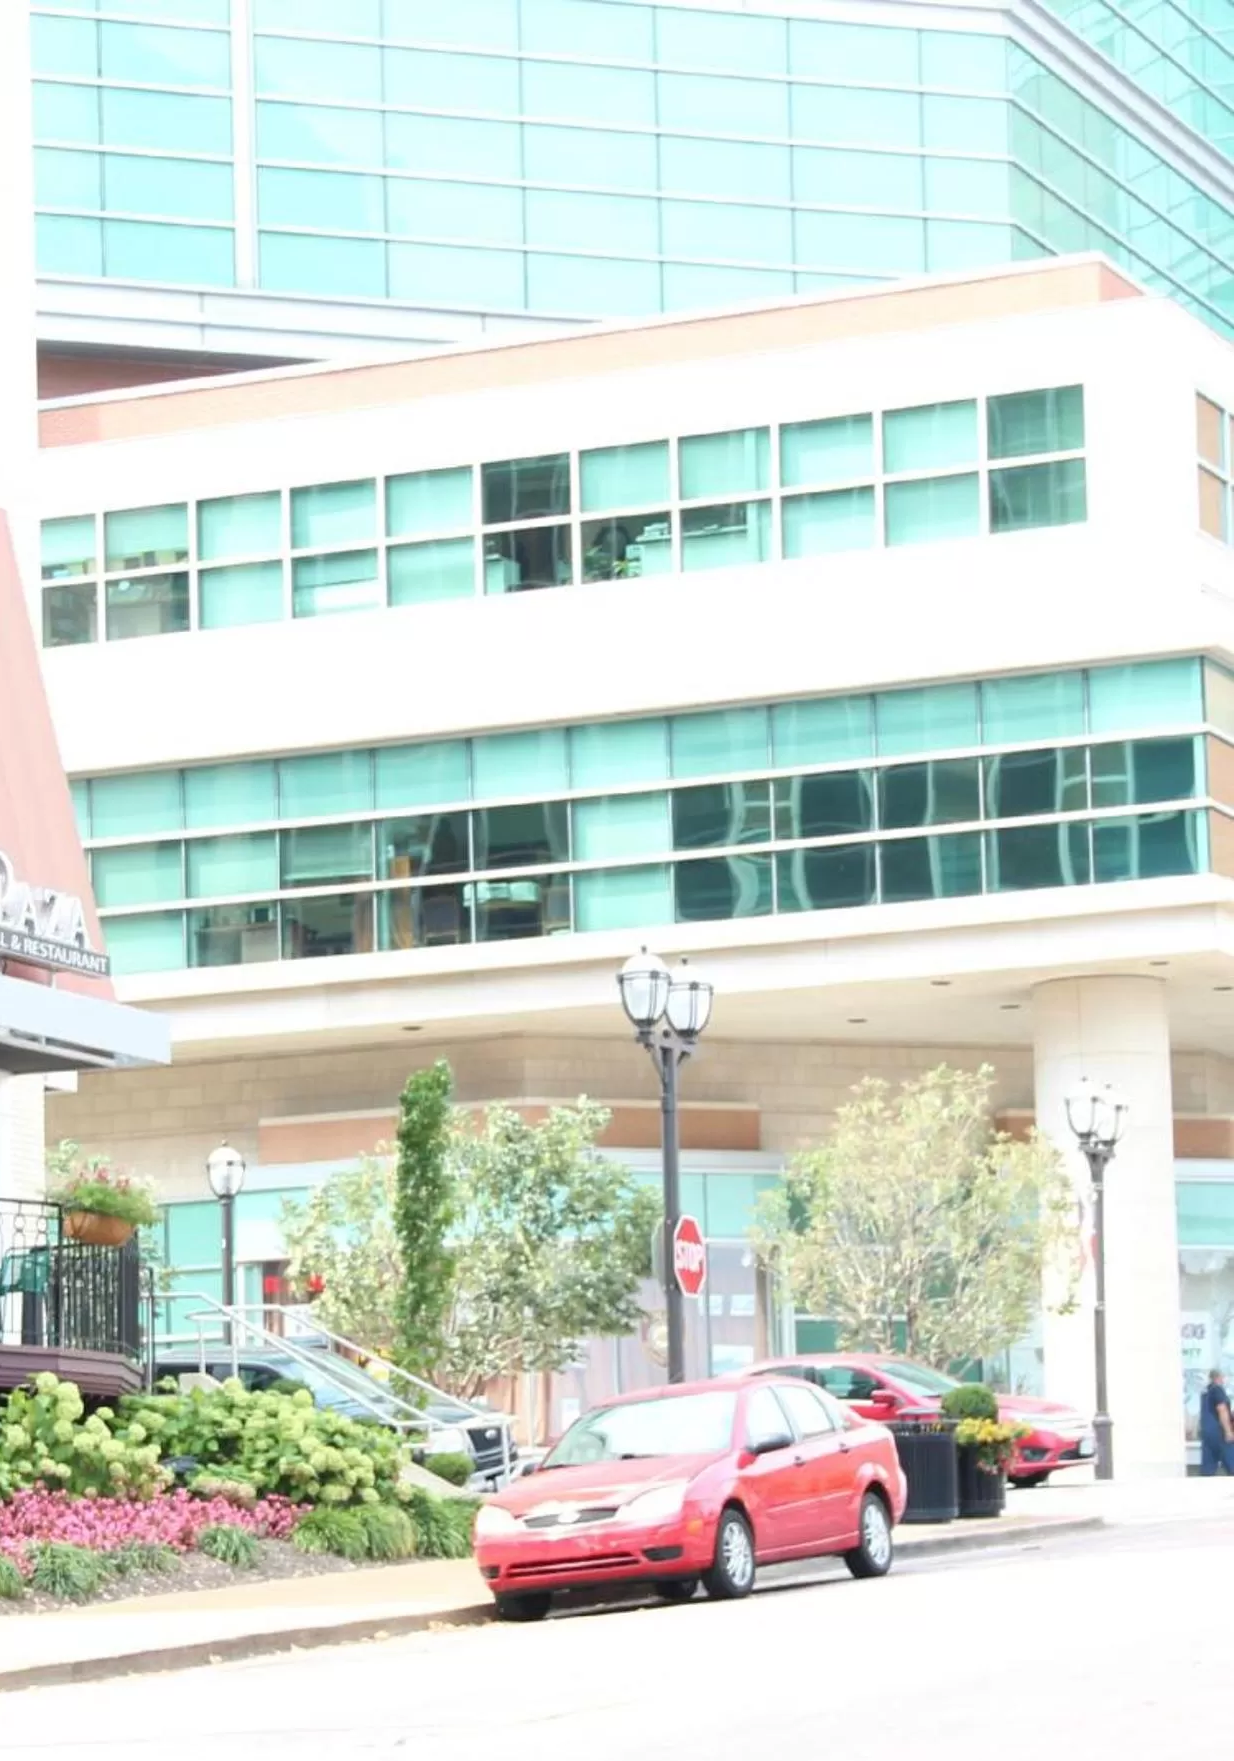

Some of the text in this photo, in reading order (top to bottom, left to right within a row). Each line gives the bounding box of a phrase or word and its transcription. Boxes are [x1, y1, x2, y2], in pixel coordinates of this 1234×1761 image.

[10, 933, 22, 952] &
[23, 937, 108, 974] RESTAURANT
[676, 1239, 704, 1273] STOP
